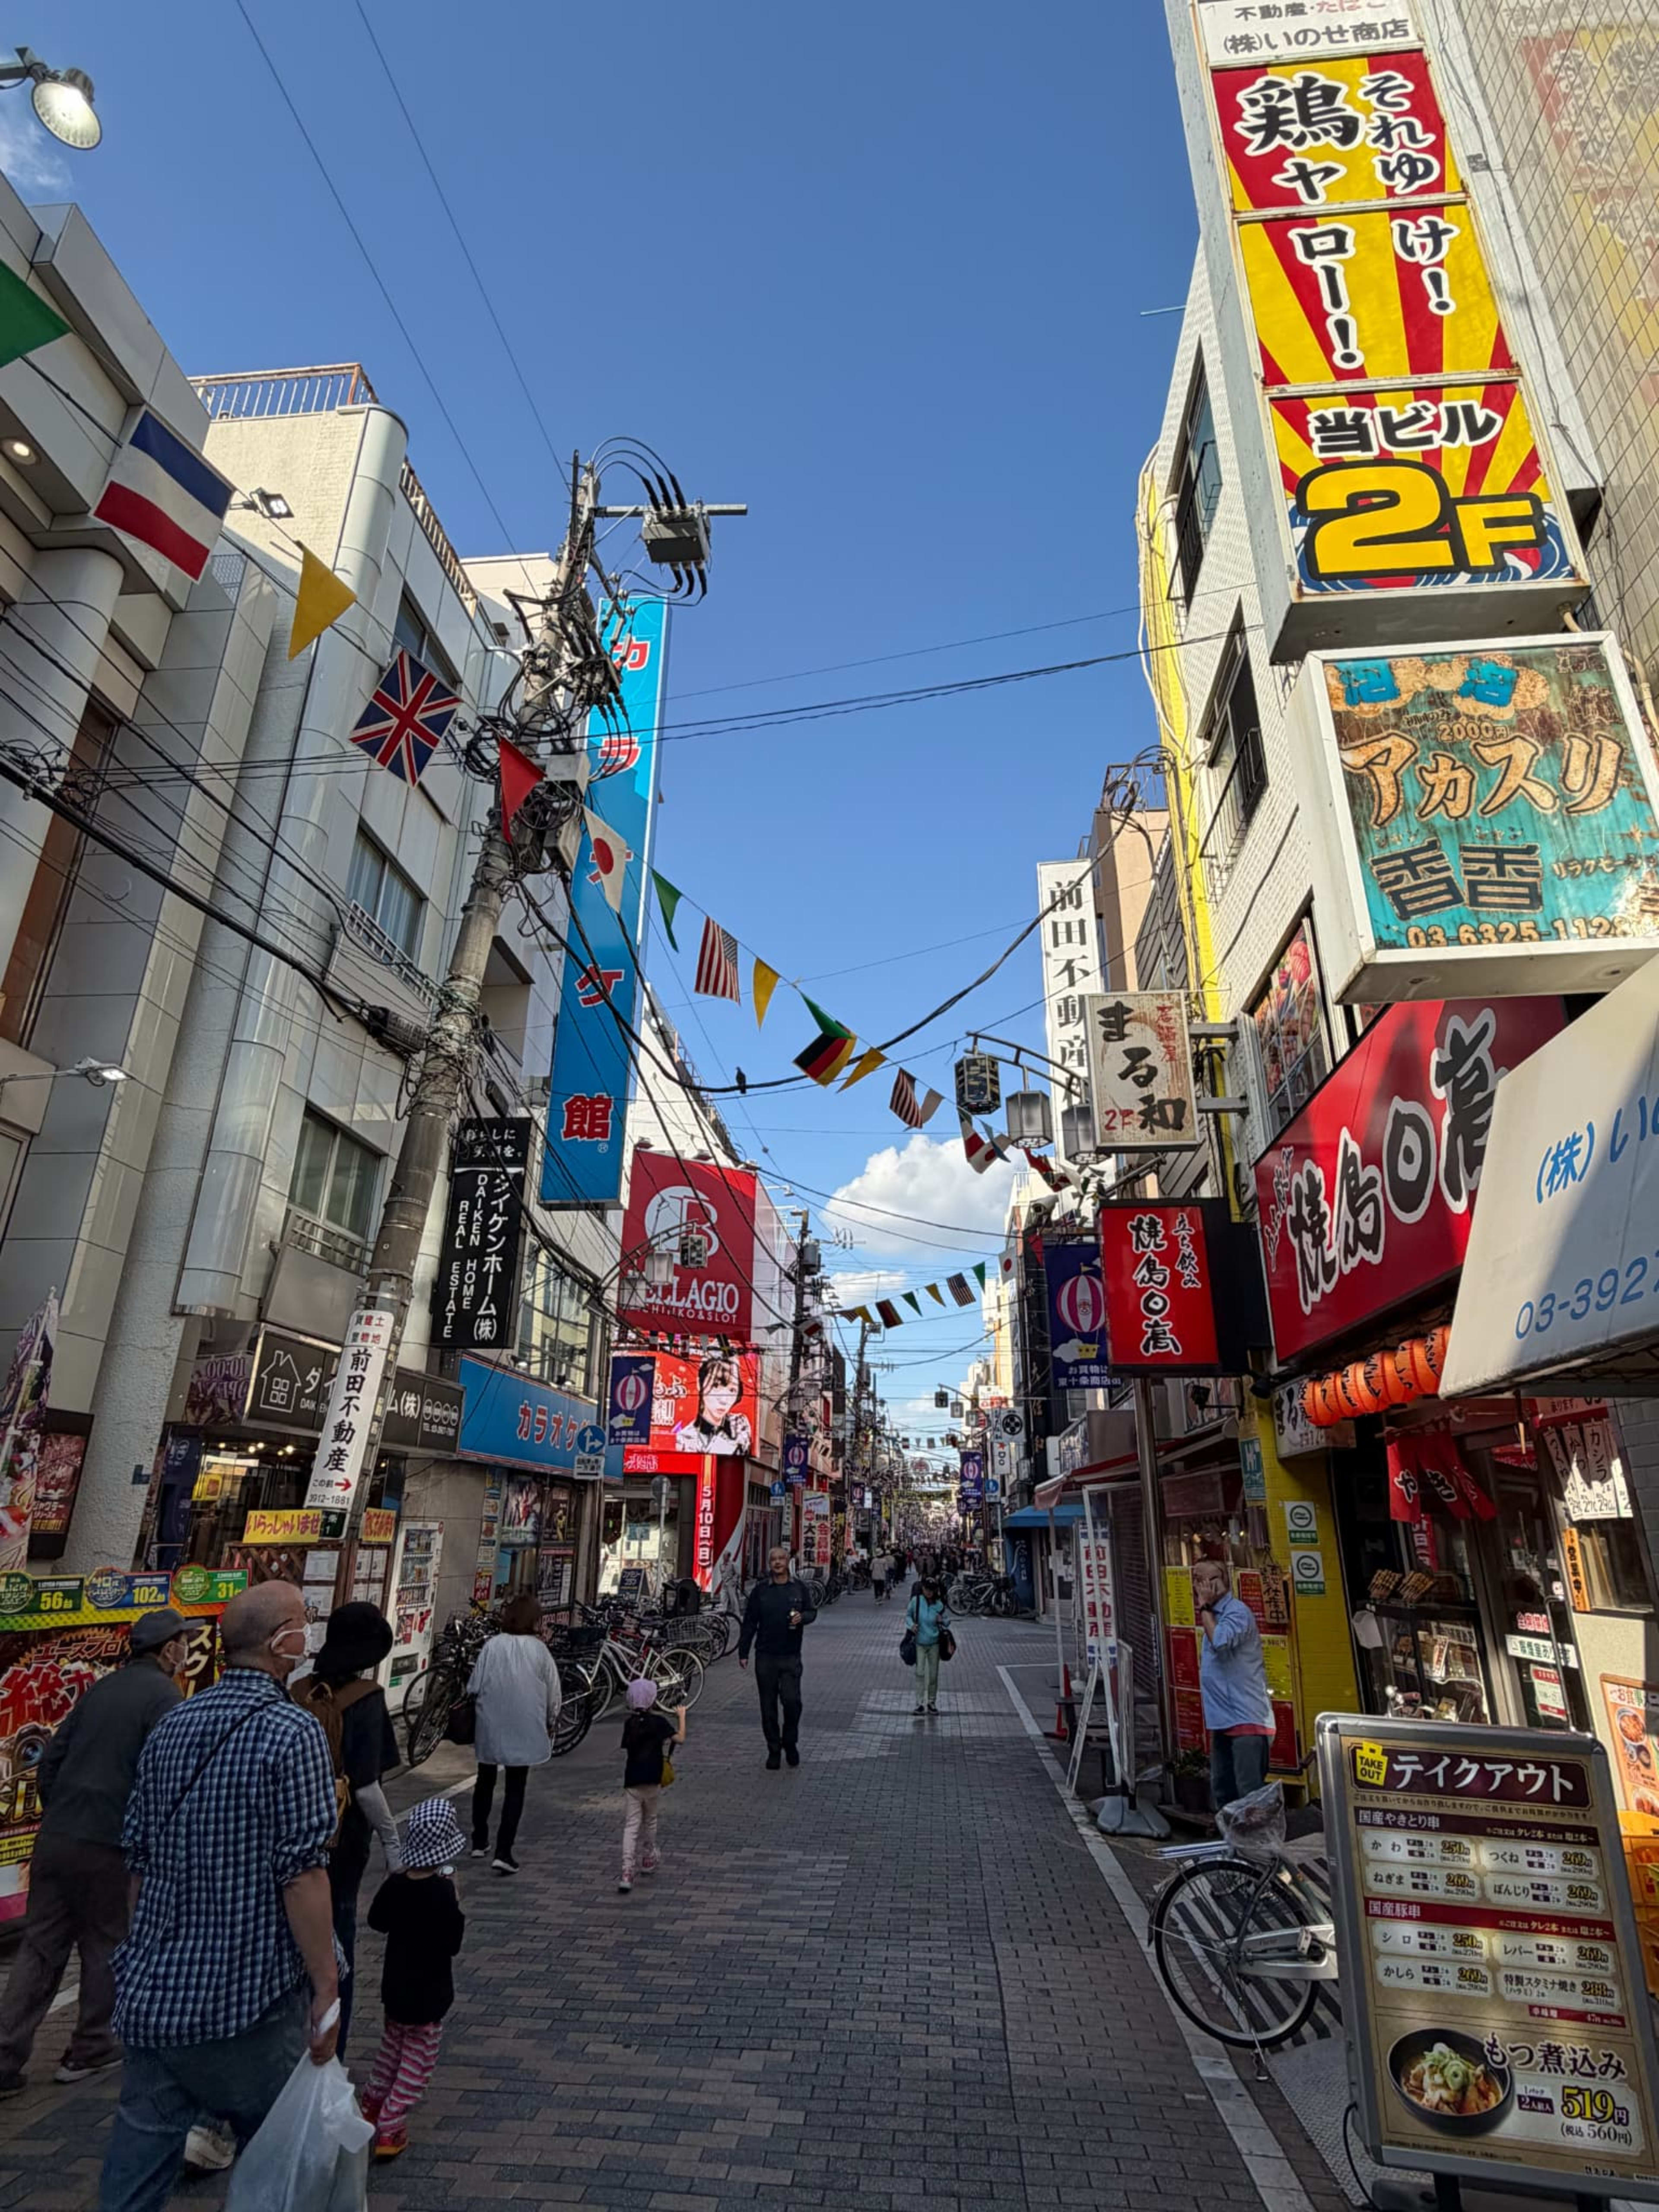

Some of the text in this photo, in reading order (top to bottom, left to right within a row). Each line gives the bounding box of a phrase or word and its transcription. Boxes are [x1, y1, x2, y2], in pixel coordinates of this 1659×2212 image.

[1223, 19, 1410, 54] (株)いのせ商店
[1307, 400, 1503, 458] 当ビル
[1297, 459, 1547, 580] 2F
[1339, 730, 1624, 829] アカスリ
[1370, 837, 1544, 921] 香香
[1536, 1095, 1659, 1205] (株)い
[462, 1174, 488, 1310] DAIKEN HOME
[443, 1200, 470, 1338] REAL ESTATE
[1514, 1250, 1659, 1340] 03-392
[323, 1348, 373, 1473] 前田不動産
[517, 1400, 590, 1451] カラオケ
[1359, 1755, 1383, 1770] TAKE
[1360, 1767, 1382, 1780] OUT
[1392, 1754, 1573, 1802] テイクアウト
[1359, 1809, 1440, 1830] 国産やきとり串
[1373, 1871, 1404, 1885] ねぎま
[1489, 1851, 1519, 1863] つくね
[1383, 1966, 1414, 1980] かしら
[1503, 1945, 1533, 1955] レバー
[1485, 2031, 1626, 2079] もつ煮込み
[1560, 2085, 1629, 2126] 519円
